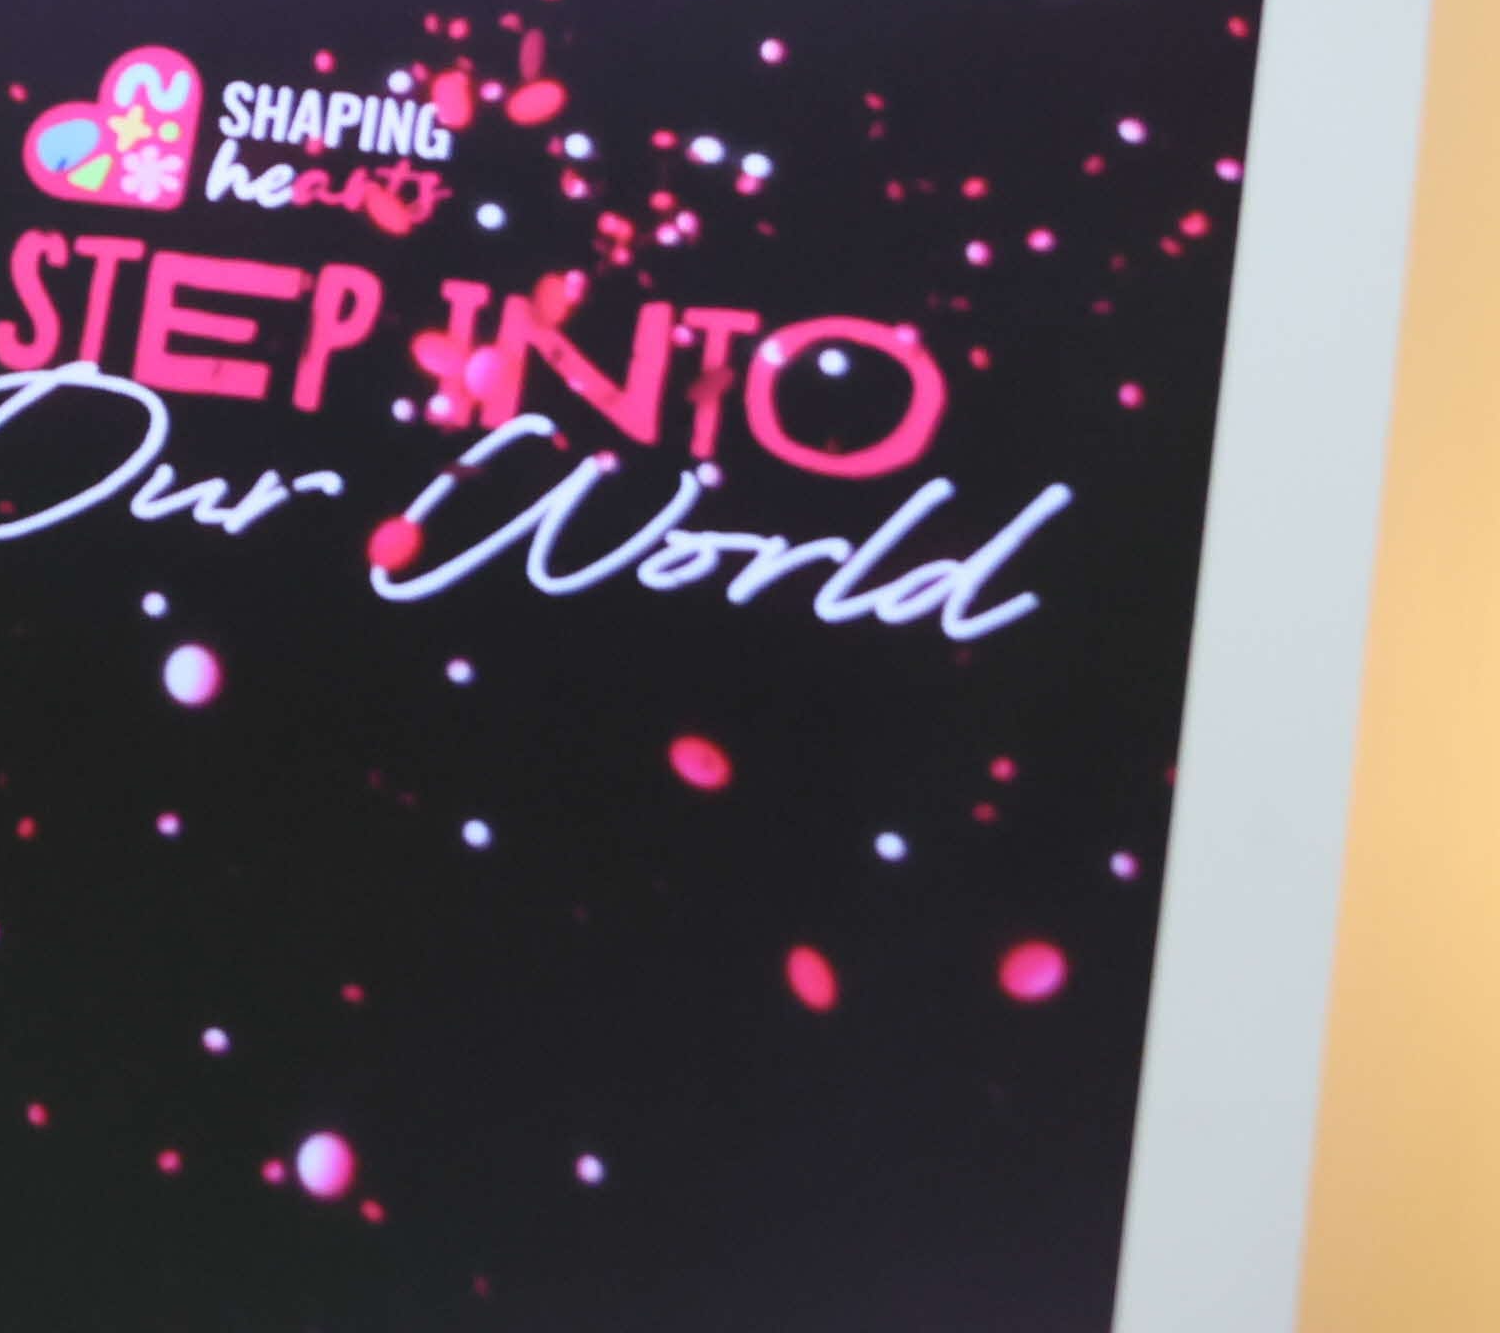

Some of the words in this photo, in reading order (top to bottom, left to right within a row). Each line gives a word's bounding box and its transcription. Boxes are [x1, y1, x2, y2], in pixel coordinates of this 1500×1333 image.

[218, 80, 453, 161] SHAPING
[424, 277, 947, 478] INTO
[368, 414, 1073, 642] World
